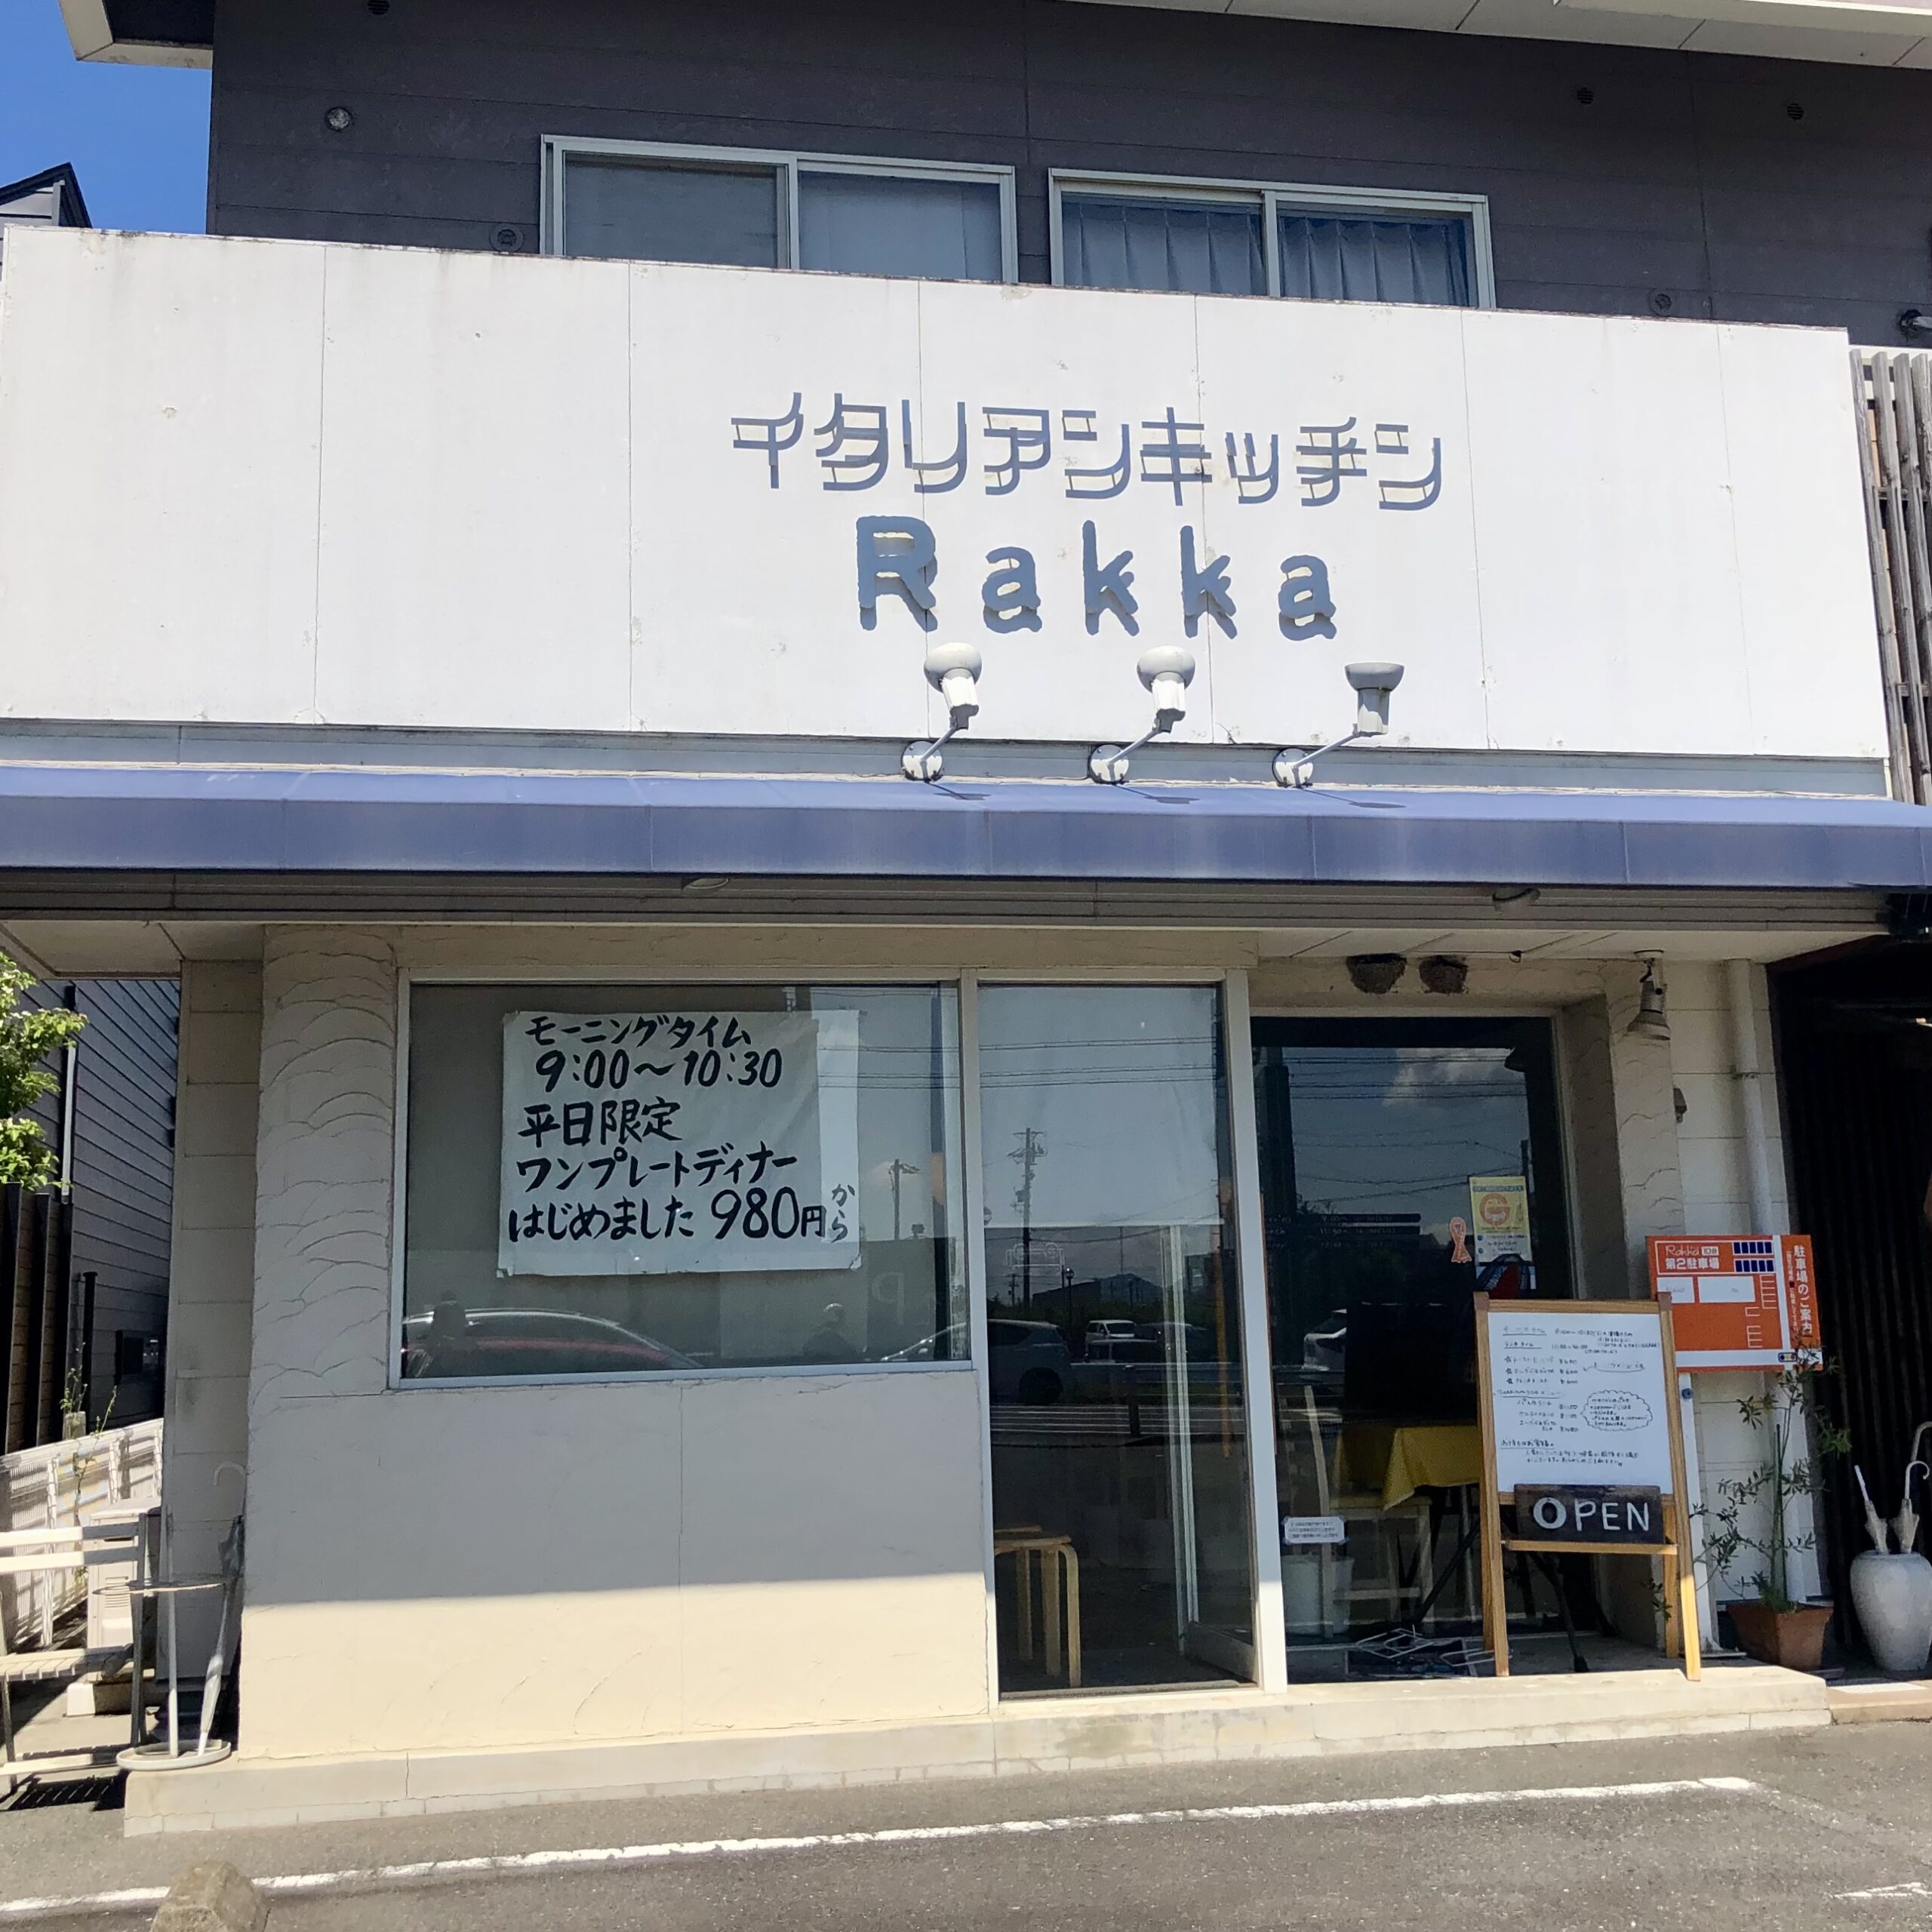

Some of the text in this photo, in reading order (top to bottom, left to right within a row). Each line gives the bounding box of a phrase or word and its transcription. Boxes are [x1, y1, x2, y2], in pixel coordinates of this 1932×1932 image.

[731, 392, 1441, 510] イタリアンキッチン
[856, 515, 1337, 639] Rakka
[525, 1014, 752, 1049] モーニングタイム
[518, 1096, 682, 1148] 平日限定
[516, 1140, 798, 1192] ワンプレートディナー
[509, 1195, 694, 1242] はじめました
[1533, 1497, 1649, 1531] OPEN
